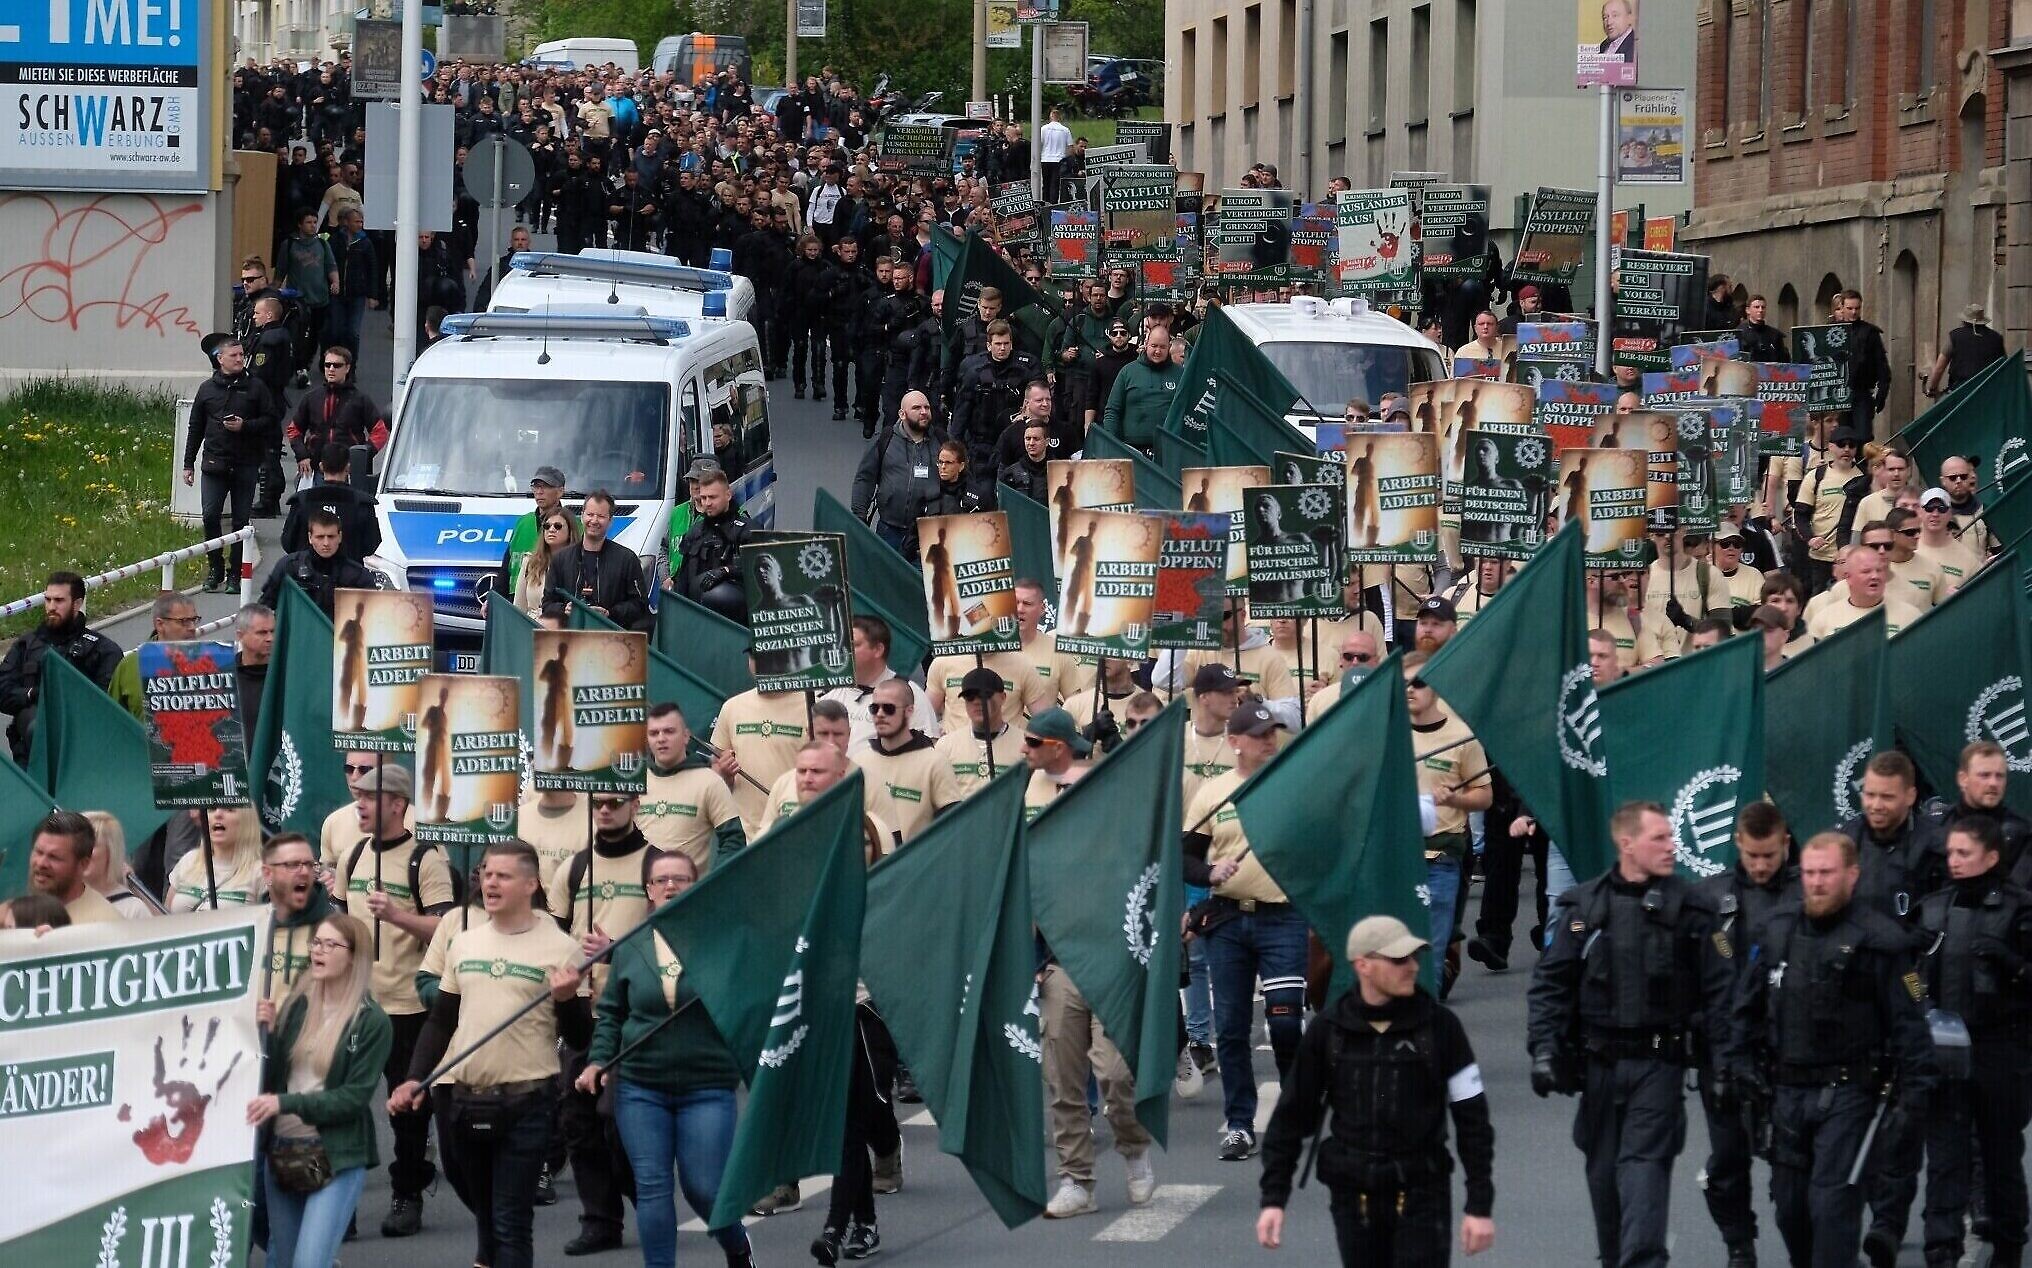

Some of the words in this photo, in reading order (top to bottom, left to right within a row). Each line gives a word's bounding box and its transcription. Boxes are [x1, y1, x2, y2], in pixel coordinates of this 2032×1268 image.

[19, 67, 55, 81] MIETEN
[58, 68, 74, 82] SIE
[77, 69, 105, 82] DIESE
[108, 68, 179, 84] WERBEFLÄCHE
[1635, 103, 1677, 115] Frühling
[19, 93, 164, 146] SCHWARZ
[110, 152, 181, 163] www.schwarz-aw.de
[1105, 185, 1172, 199] ASYLFLUT
[1006, 201, 1034, 213] RAUS!
[1105, 200, 1169, 211] STOPPEN!
[1226, 198, 1261, 206] EUROPA
[1339, 195, 1406, 214] AUSLÄNDER
[1428, 203, 1485, 212] VERTEIDIGEN!
[1226, 210, 1286, 218] VERTEIDIGEN!
[1340, 214, 1373, 225] RAUS!
[1427, 215, 1464, 224] GRENZEN
[1531, 210, 1592, 221] ASYLFLUT
[1053, 224, 1096, 232] ASYLFLUT
[1225, 222, 1265, 231] GRENZEN
[1426, 228, 1454, 236] DICHT!
[1528, 223, 1585, 235] STOPPEN!
[1054, 231, 1096, 240] STOPPEN!
[1224, 235, 1255, 244] DICHT!
[1626, 261, 1691, 273] RESERVIERT
[1624, 275, 1646, 284] FÜR
[1624, 290, 1662, 300] VOLKS-
[1623, 305, 1678, 317] VERRÄTER
[1520, 341, 1583, 354] ASYLFLUT
[1542, 402, 1613, 415] ASYLFLUT
[1543, 414, 1596, 427] STOPPE
[1481, 424, 1530, 434] ARBEIT
[1380, 475, 1435, 491] ARBEIT
[1465, 486, 1487, 497] FÜR
[1488, 488, 1521, 499] EINEN
[1592, 488, 1647, 503] ARBEIT
[1381, 493, 1436, 509] ADELT!
[1465, 499, 1528, 511] DEUTSCHEN
[323, 505, 336, 514] SN
[1594, 505, 1646, 519] ADELT!
[1464, 512, 1537, 524] SOZIALISMUS!
[1249, 545, 1273, 556] FÜR
[1274, 544, 1310, 554] EINEN
[1461, 546, 1480, 555] DER
[1250, 556, 1319, 569] DEUTSCHEN
[1350, 554, 1375, 562] DER
[1377, 553, 1412, 562] DRITTE
[1414, 553, 1437, 562] WEG
[1622, 560, 1644, 568] WEG
[956, 558, 1011, 578] ARBEIT
[1097, 562, 1157, 576] ARBEIT
[1250, 569, 1331, 582] SOZIALISMUS!
[960, 577, 1014, 598] ADELT!
[1096, 582, 1154, 597] ADELT!
[752, 610, 776, 623] FÜR
[777, 606, 815, 619] EINEN
[1251, 609, 1274, 617] DER
[1276, 608, 1317, 617] DRITTE
[1319, 607, 1344, 615] WEG
[754, 620, 824, 638] DEUTSCHEN
[755, 633, 838, 652] SOZIALISMUS!
[934, 645, 955, 656] DER
[958, 643, 995, 655] DRITTE
[997, 641, 1021, 651] WEG
[369, 645, 430, 662] ARBEIT
[1056, 642, 1078, 652] DER
[1080, 644, 1119, 657] DRITTE
[1121, 649, 1147, 660] WEG
[457, 656, 476, 671] DD
[147, 673, 234, 694] ASYLFLUT
[758, 681, 782, 692] DER
[784, 677, 825, 689] DRITTE
[827, 675, 853, 685] WEG
[576, 684, 644, 702] ARBEIT
[150, 693, 236, 711] STOPPEN!
[577, 706, 645, 724] ADELT!
[334, 739, 357, 749] DER
[359, 740, 400, 752] DRITTE
[454, 732, 517, 749] ARBEIT
[455, 756, 517, 774] ADELT!
[536, 779, 562, 789] DER
[566, 780, 612, 791] DRITTE
[615, 782, 645, 792] WEG
[417, 831, 439, 841] DER
[442, 832, 486, 844] DRITTE
[0, 935, 249, 1022] CHTIGKEIT
[1, 1063, 108, 1115] ÄNDER!
